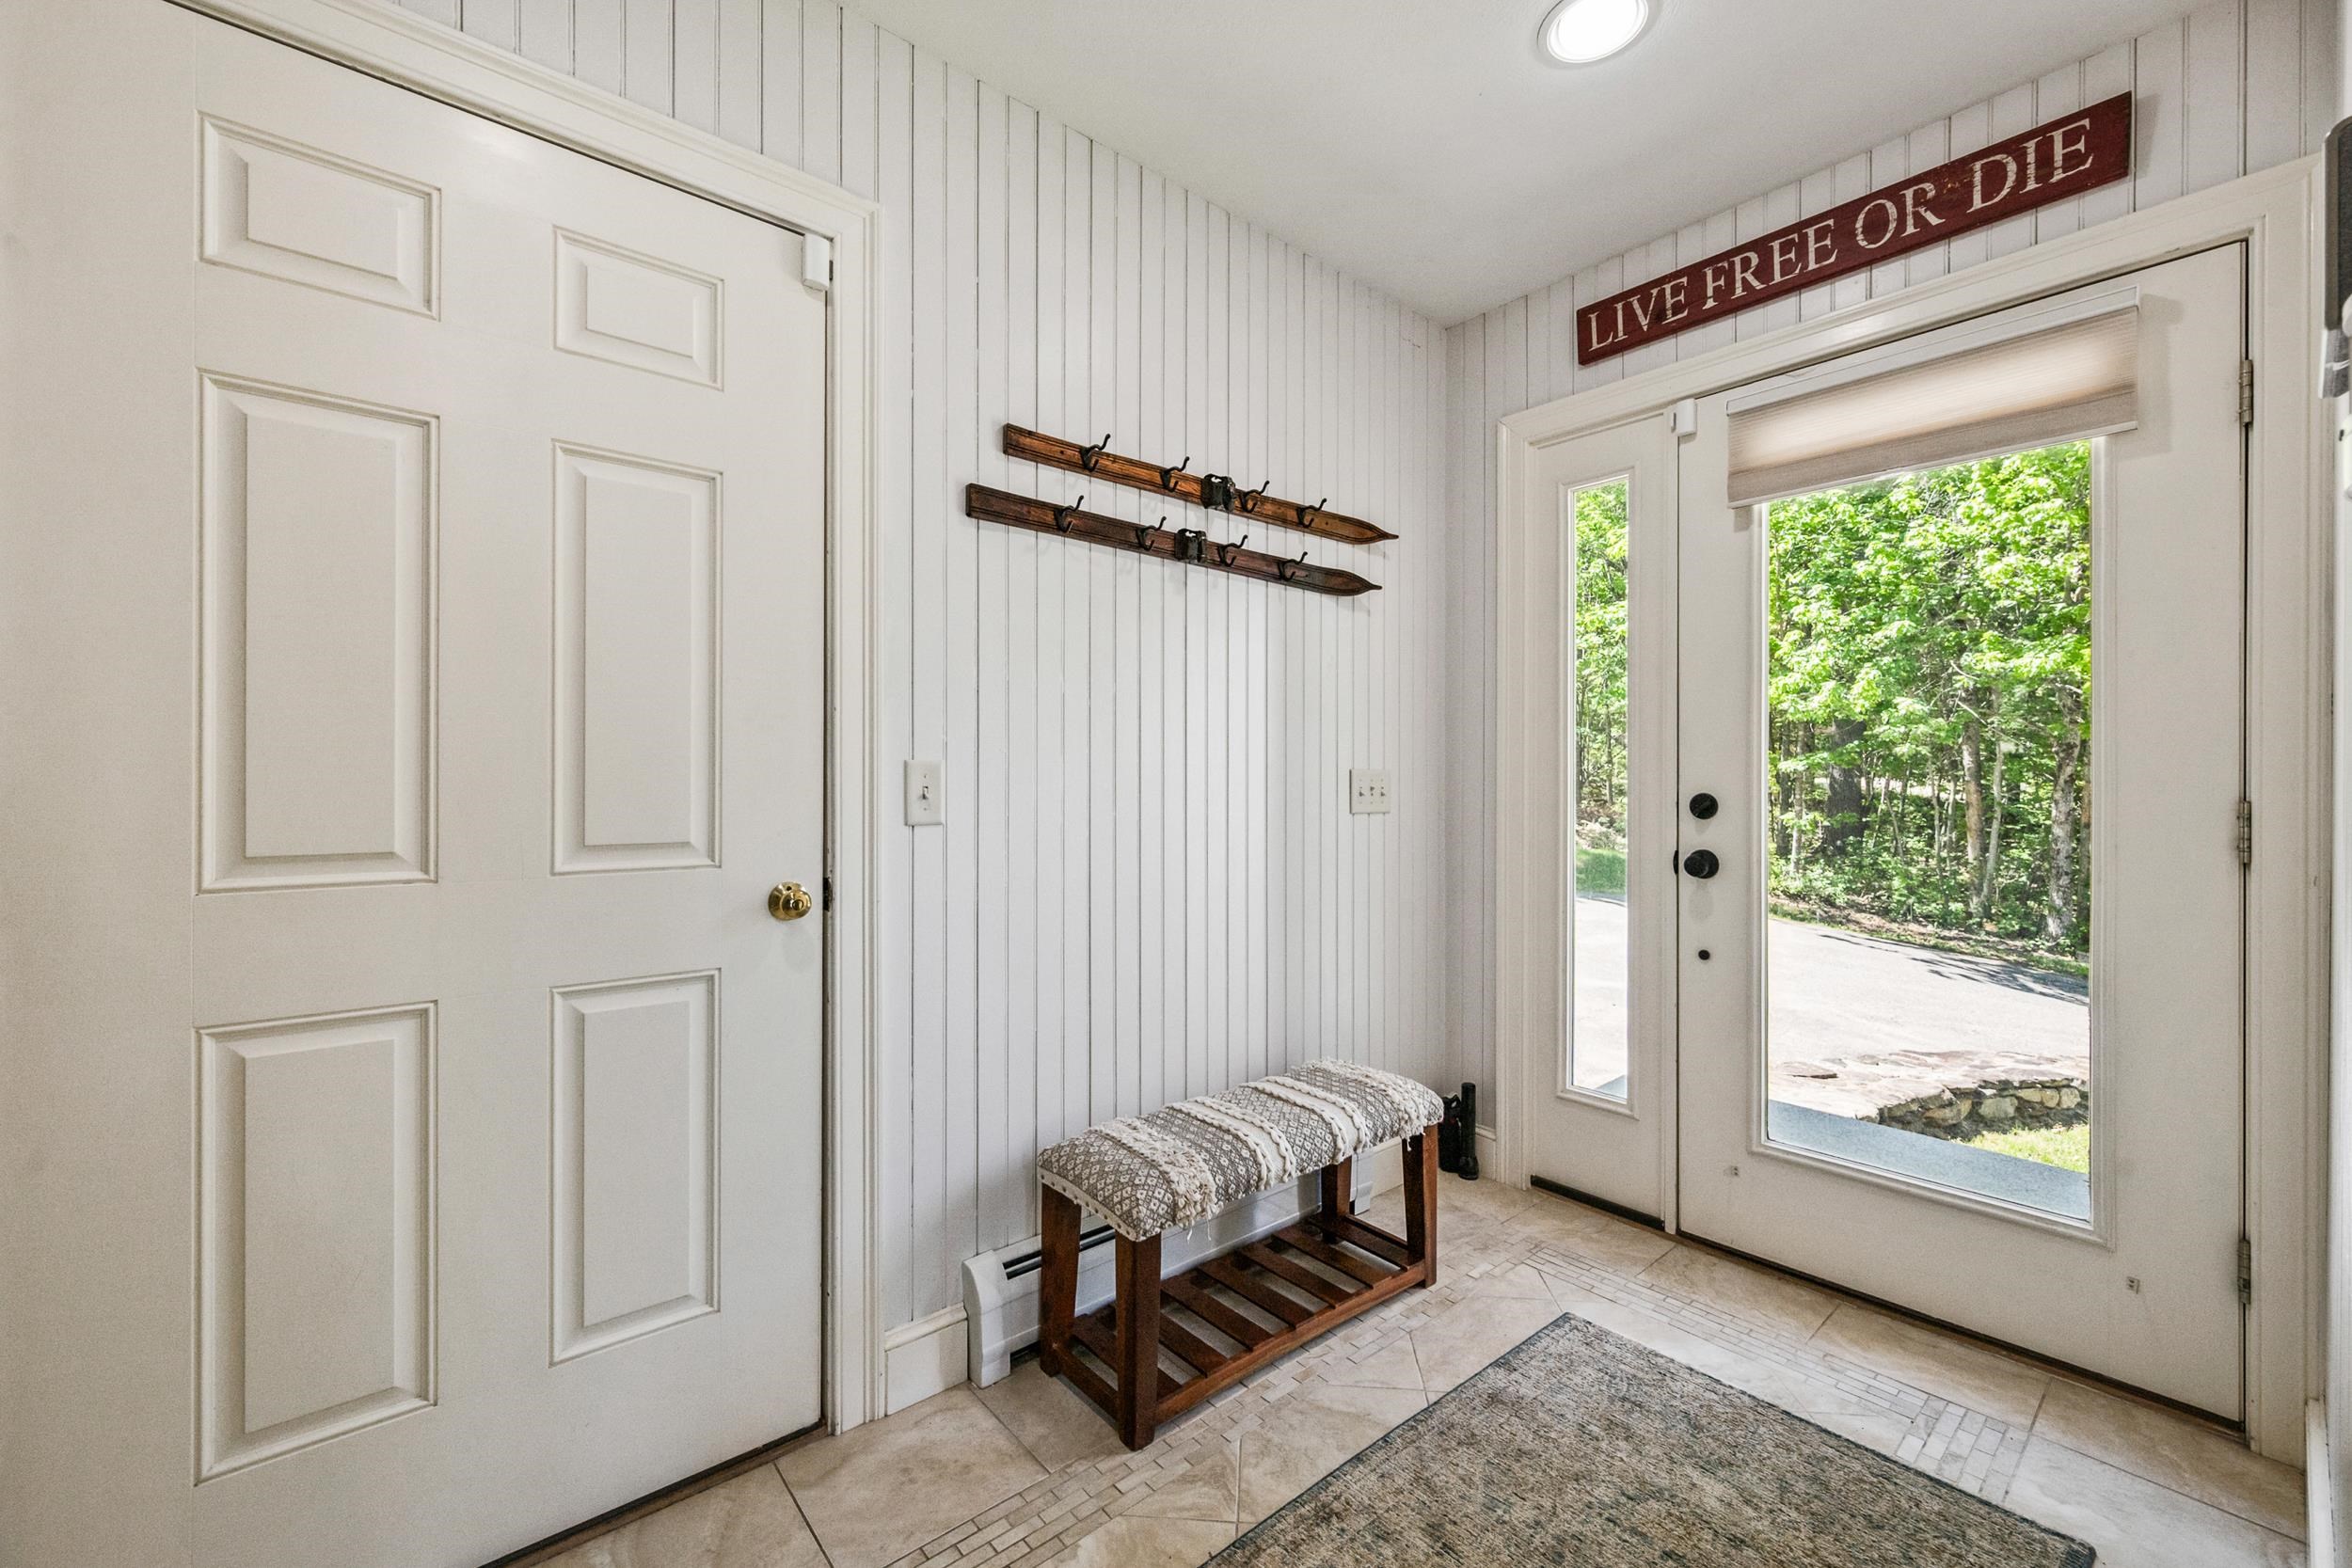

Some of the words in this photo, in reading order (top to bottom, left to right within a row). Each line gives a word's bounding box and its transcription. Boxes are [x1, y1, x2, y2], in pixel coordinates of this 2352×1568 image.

[1588, 277, 1689, 352] LIVE
[1701, 219, 1838, 309] FREE
[1855, 182, 1946, 249] OR
[1967, 118, 2094, 213] DIE
